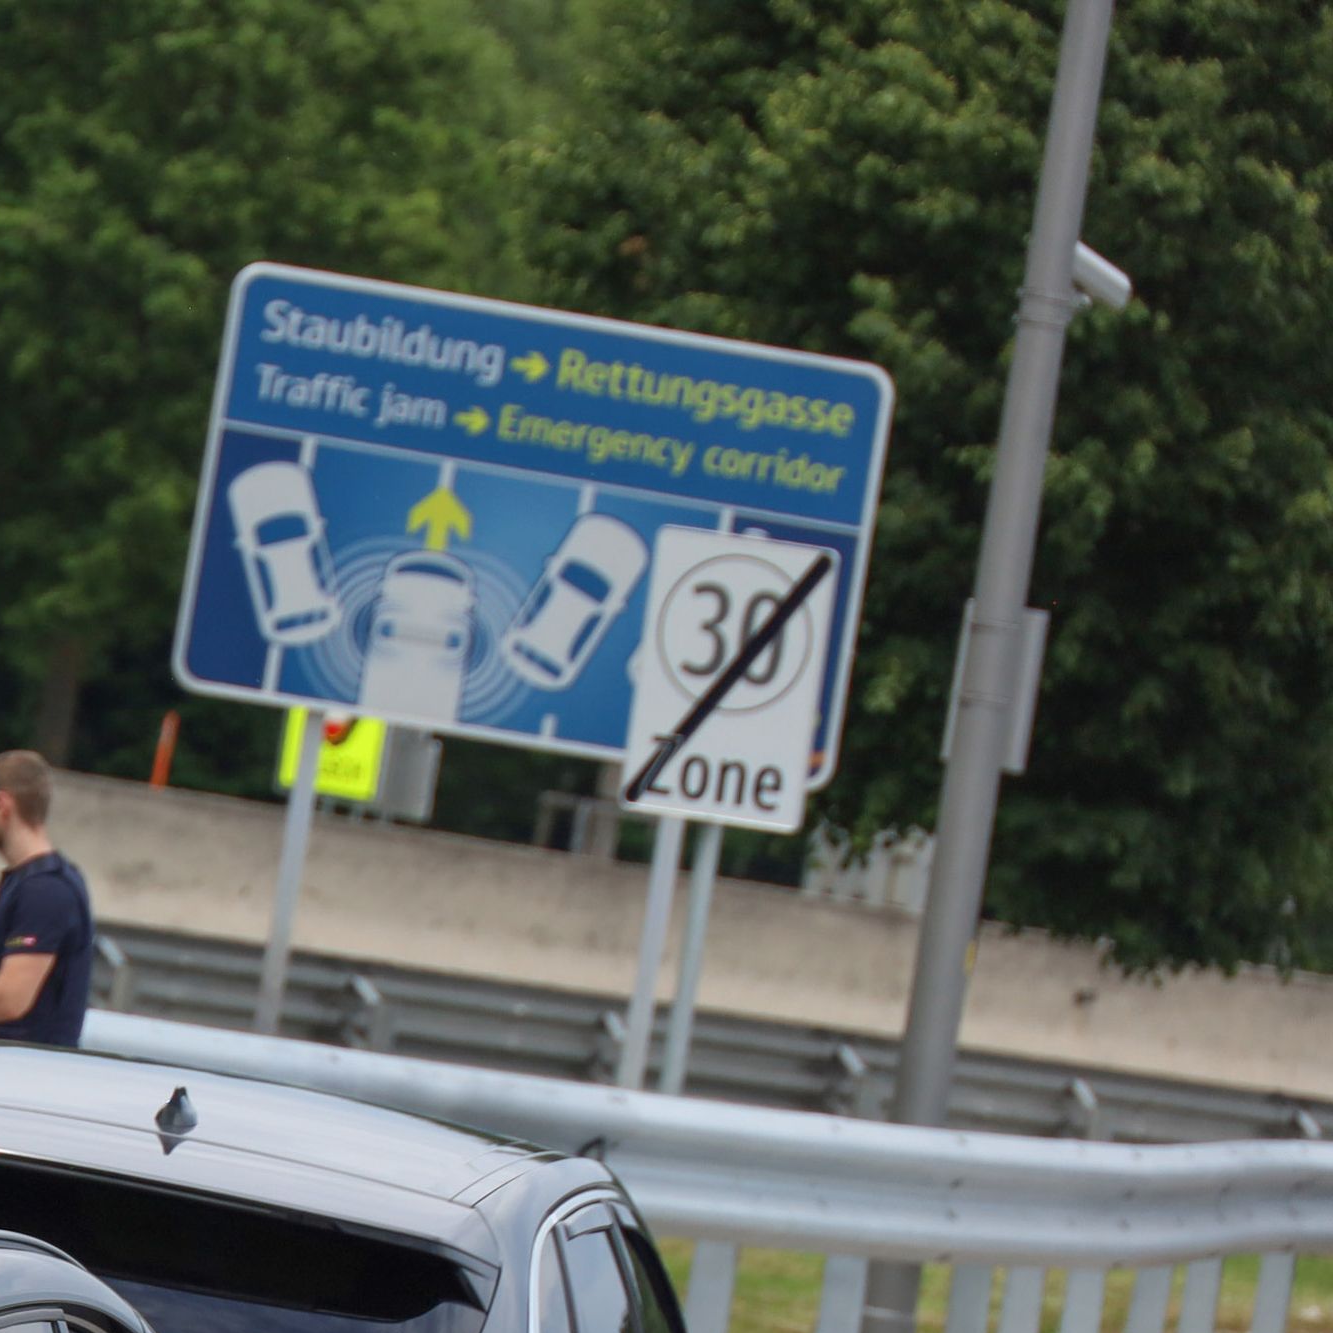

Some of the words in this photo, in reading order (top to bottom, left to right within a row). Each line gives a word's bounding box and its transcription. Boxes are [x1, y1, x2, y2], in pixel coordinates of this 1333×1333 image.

[260, 299, 506, 387] Staubildung
[555, 347, 855, 438] Rettungsgasse
[255, 363, 372, 419] Traffic
[374, 382, 447, 430] jam
[497, 403, 697, 476] Emergency
[701, 444, 847, 493] corridor
[681, 580, 785, 685] 30
[645, 733, 783, 811] Zone
